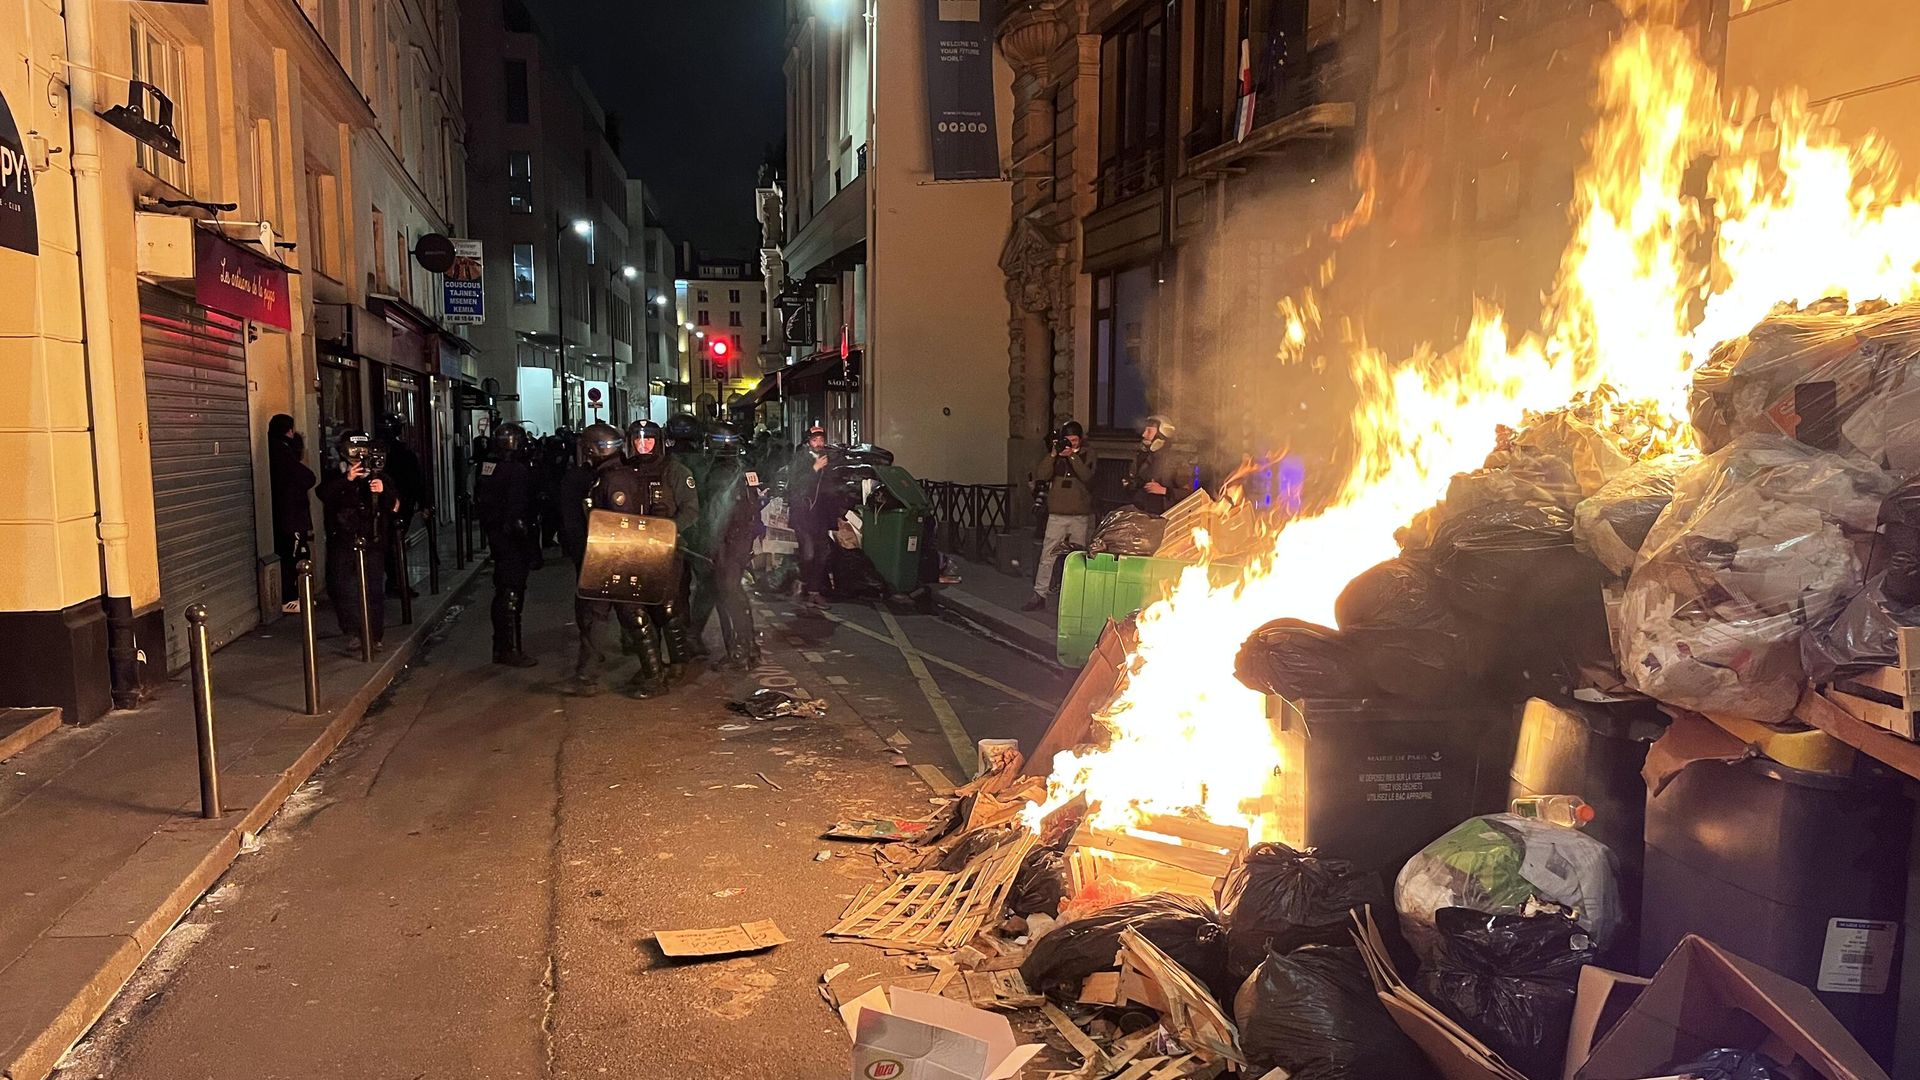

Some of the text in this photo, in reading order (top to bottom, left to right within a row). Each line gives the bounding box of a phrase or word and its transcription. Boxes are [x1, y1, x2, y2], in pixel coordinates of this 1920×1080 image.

[445, 281, 481, 289] COUSCOUS
[450, 297, 477, 305] MSEMEN
[1396, 792, 1406, 801] BAC
